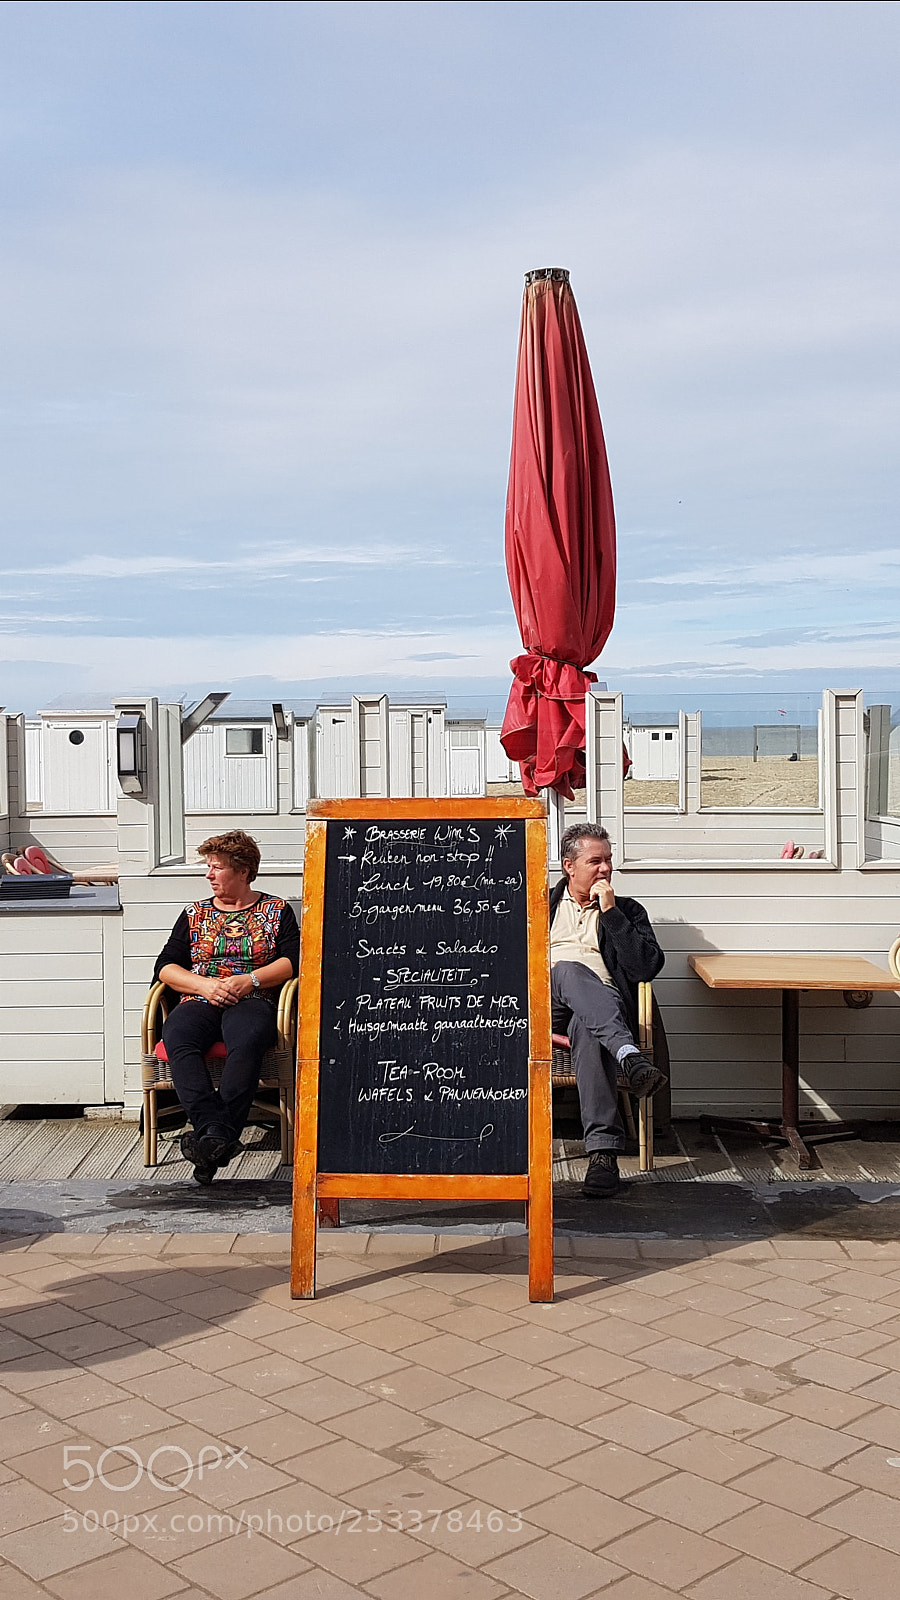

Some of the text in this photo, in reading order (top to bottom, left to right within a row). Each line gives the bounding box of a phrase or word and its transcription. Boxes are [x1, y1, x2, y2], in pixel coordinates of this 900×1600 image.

[365, 825, 427, 843] BRASSERIE
[416, 852, 480, 868] non-stop
[358, 873, 415, 892] Lunch
[356, 939, 407, 959] Snacks
[356, 994, 520, 1015] PLATEAU FRUITS DE MER
[358, 1088, 414, 1103] WAFELS
